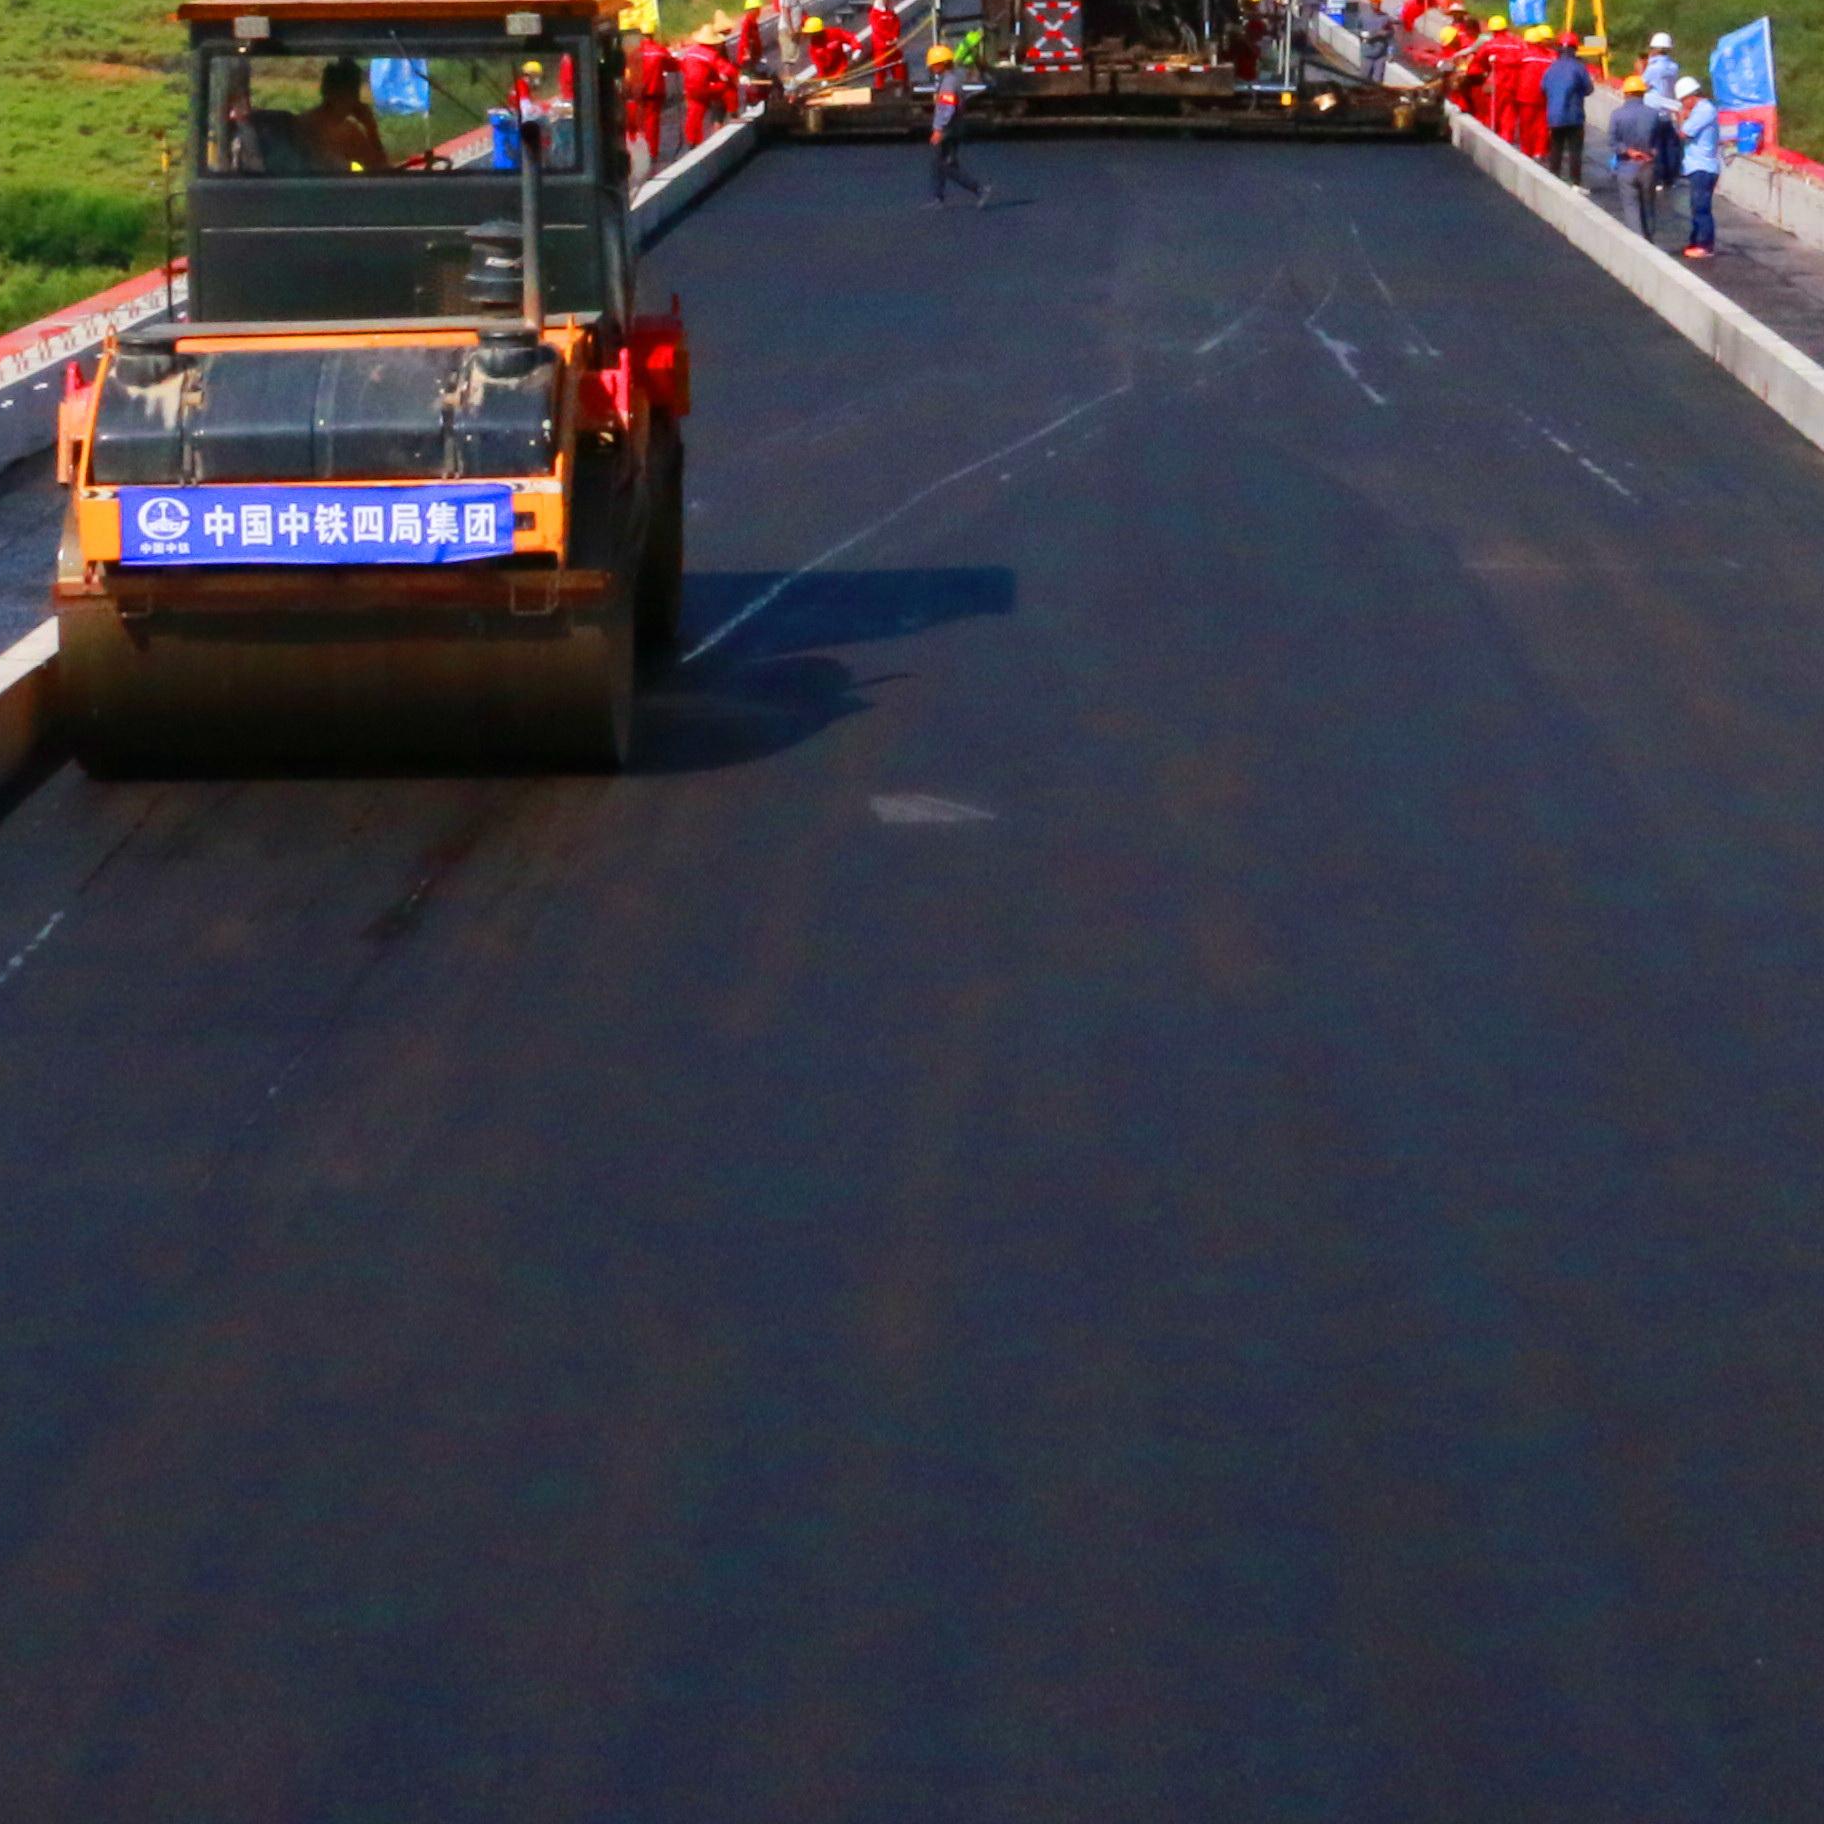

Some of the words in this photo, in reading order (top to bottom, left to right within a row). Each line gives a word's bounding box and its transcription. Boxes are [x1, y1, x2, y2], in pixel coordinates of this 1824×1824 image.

[203, 501, 497, 547] 中国中铁四局集团
